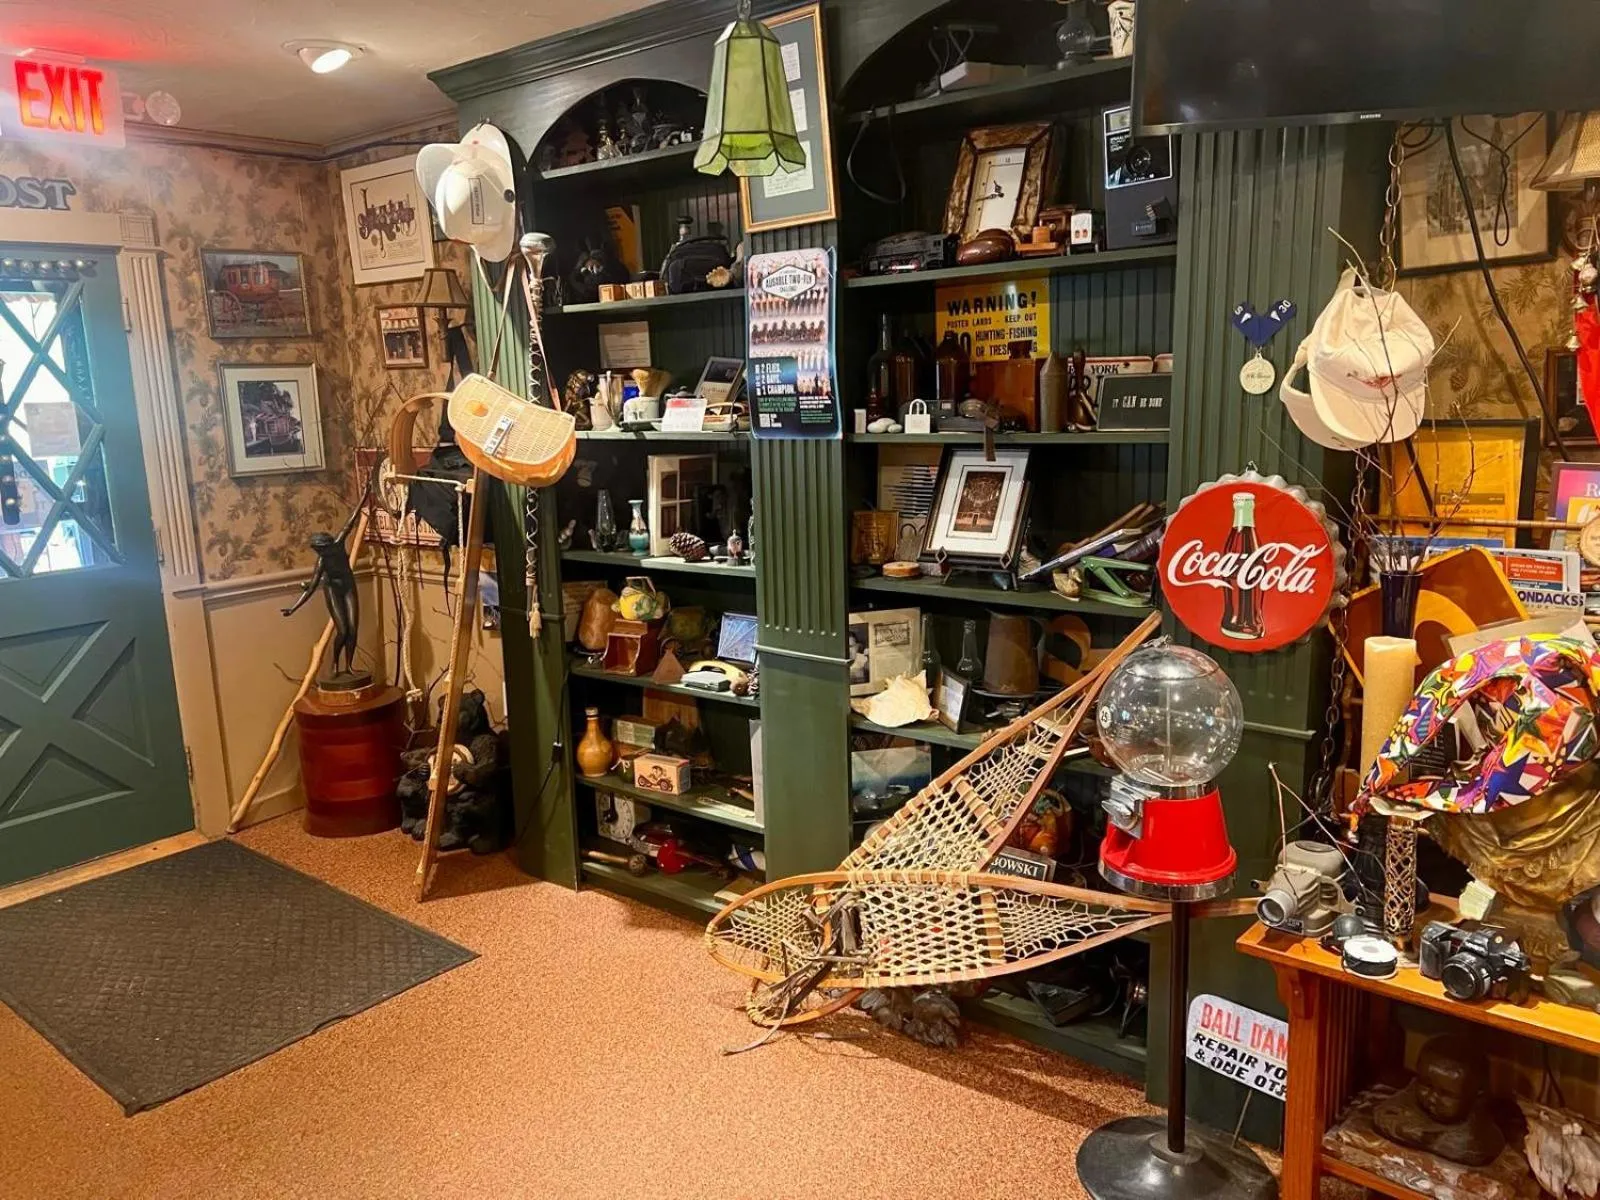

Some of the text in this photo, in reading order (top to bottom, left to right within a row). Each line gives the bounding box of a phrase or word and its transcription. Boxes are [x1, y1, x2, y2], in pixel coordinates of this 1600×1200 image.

[14, 59, 105, 136] EXIT
[946, 291, 1037, 317] WARNING!
[1005, 313, 1021, 323] KEEP
[1024, 312, 1037, 322] OUT
[1090, 364, 1120, 375] YORK
[1122, 395, 1138, 408] CAN
[1167, 539, 1329, 594] Coca-Cola
[1515, 590, 1579, 607] ONDACKS
[1199, 1002, 1242, 1043] BALL
[1192, 1032, 1259, 1070] REPAIR
[1194, 1048, 1206, 1063] &
[1210, 1056, 1250, 1081] ONE
